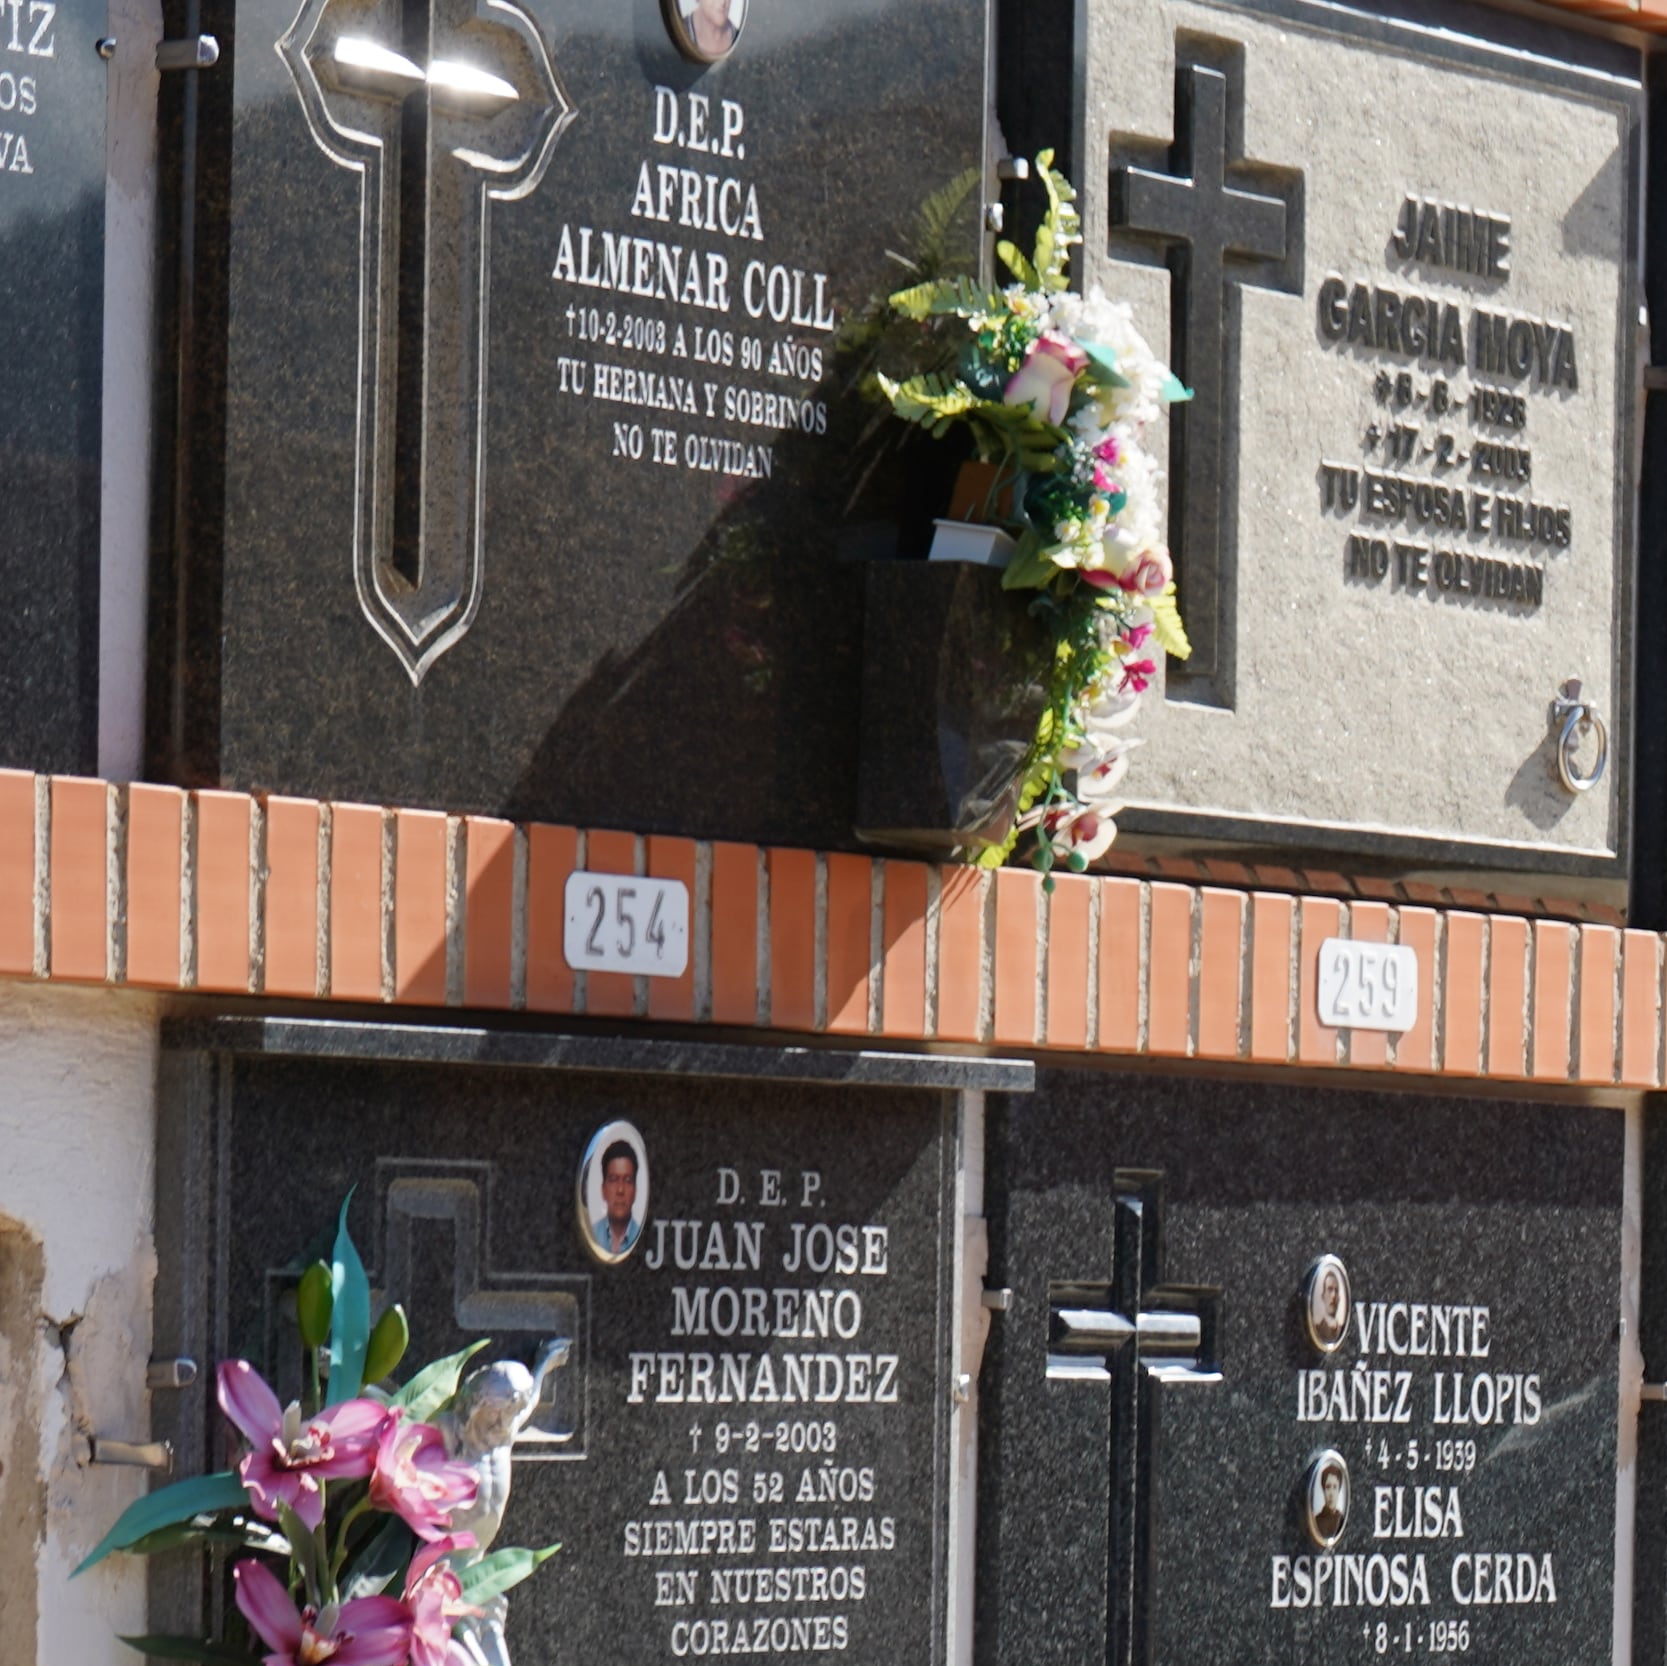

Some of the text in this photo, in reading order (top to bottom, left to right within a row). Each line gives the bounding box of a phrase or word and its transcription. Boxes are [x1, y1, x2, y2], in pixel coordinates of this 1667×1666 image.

[653, 85, 745, 160] D.E.P.
[631, 160, 764, 241] AFRICA
[1391, 192, 1511, 283] JAIME
[552, 224, 834, 331] ALMENAR COLL
[672, 324, 823, 382] A LOS 90 AÑOS
[1318, 269, 1578, 390] GARCIA MOYA
[557, 357, 827, 435] TU HERMANA Y SOBRINOS
[613, 422, 773, 479] NO TE OLVIDAN
[1364, 467, 1571, 547] ESPOSA HIJOS
[1433, 545, 1543, 606] OLVIDAN
[586, 886, 665, 960] 254
[1333, 953, 1398, 1018] 259
[645, 1220, 888, 1275] JUAN JOSE
[670, 1286, 862, 1339] MORENO
[1355, 1301, 1491, 1357] VICENTE
[627, 1352, 899, 1403] FERNANDEZ
[1296, 1360, 1542, 1425] IBAÑEZ LLOPIS
[716, 1421, 836, 1453] 9-2-2003
[650, 1458, 874, 1505] A LOS 52 AÑOS
[624, 1516, 896, 1556] SIEMPRE ESTARAS
[1373, 1485, 1464, 1538] ELISA
[655, 1565, 866, 1606] EN NUESTROS
[1270, 1552, 1557, 1608] ESPINOSA CERDA
[671, 1616, 849, 1656] CORAZONES
